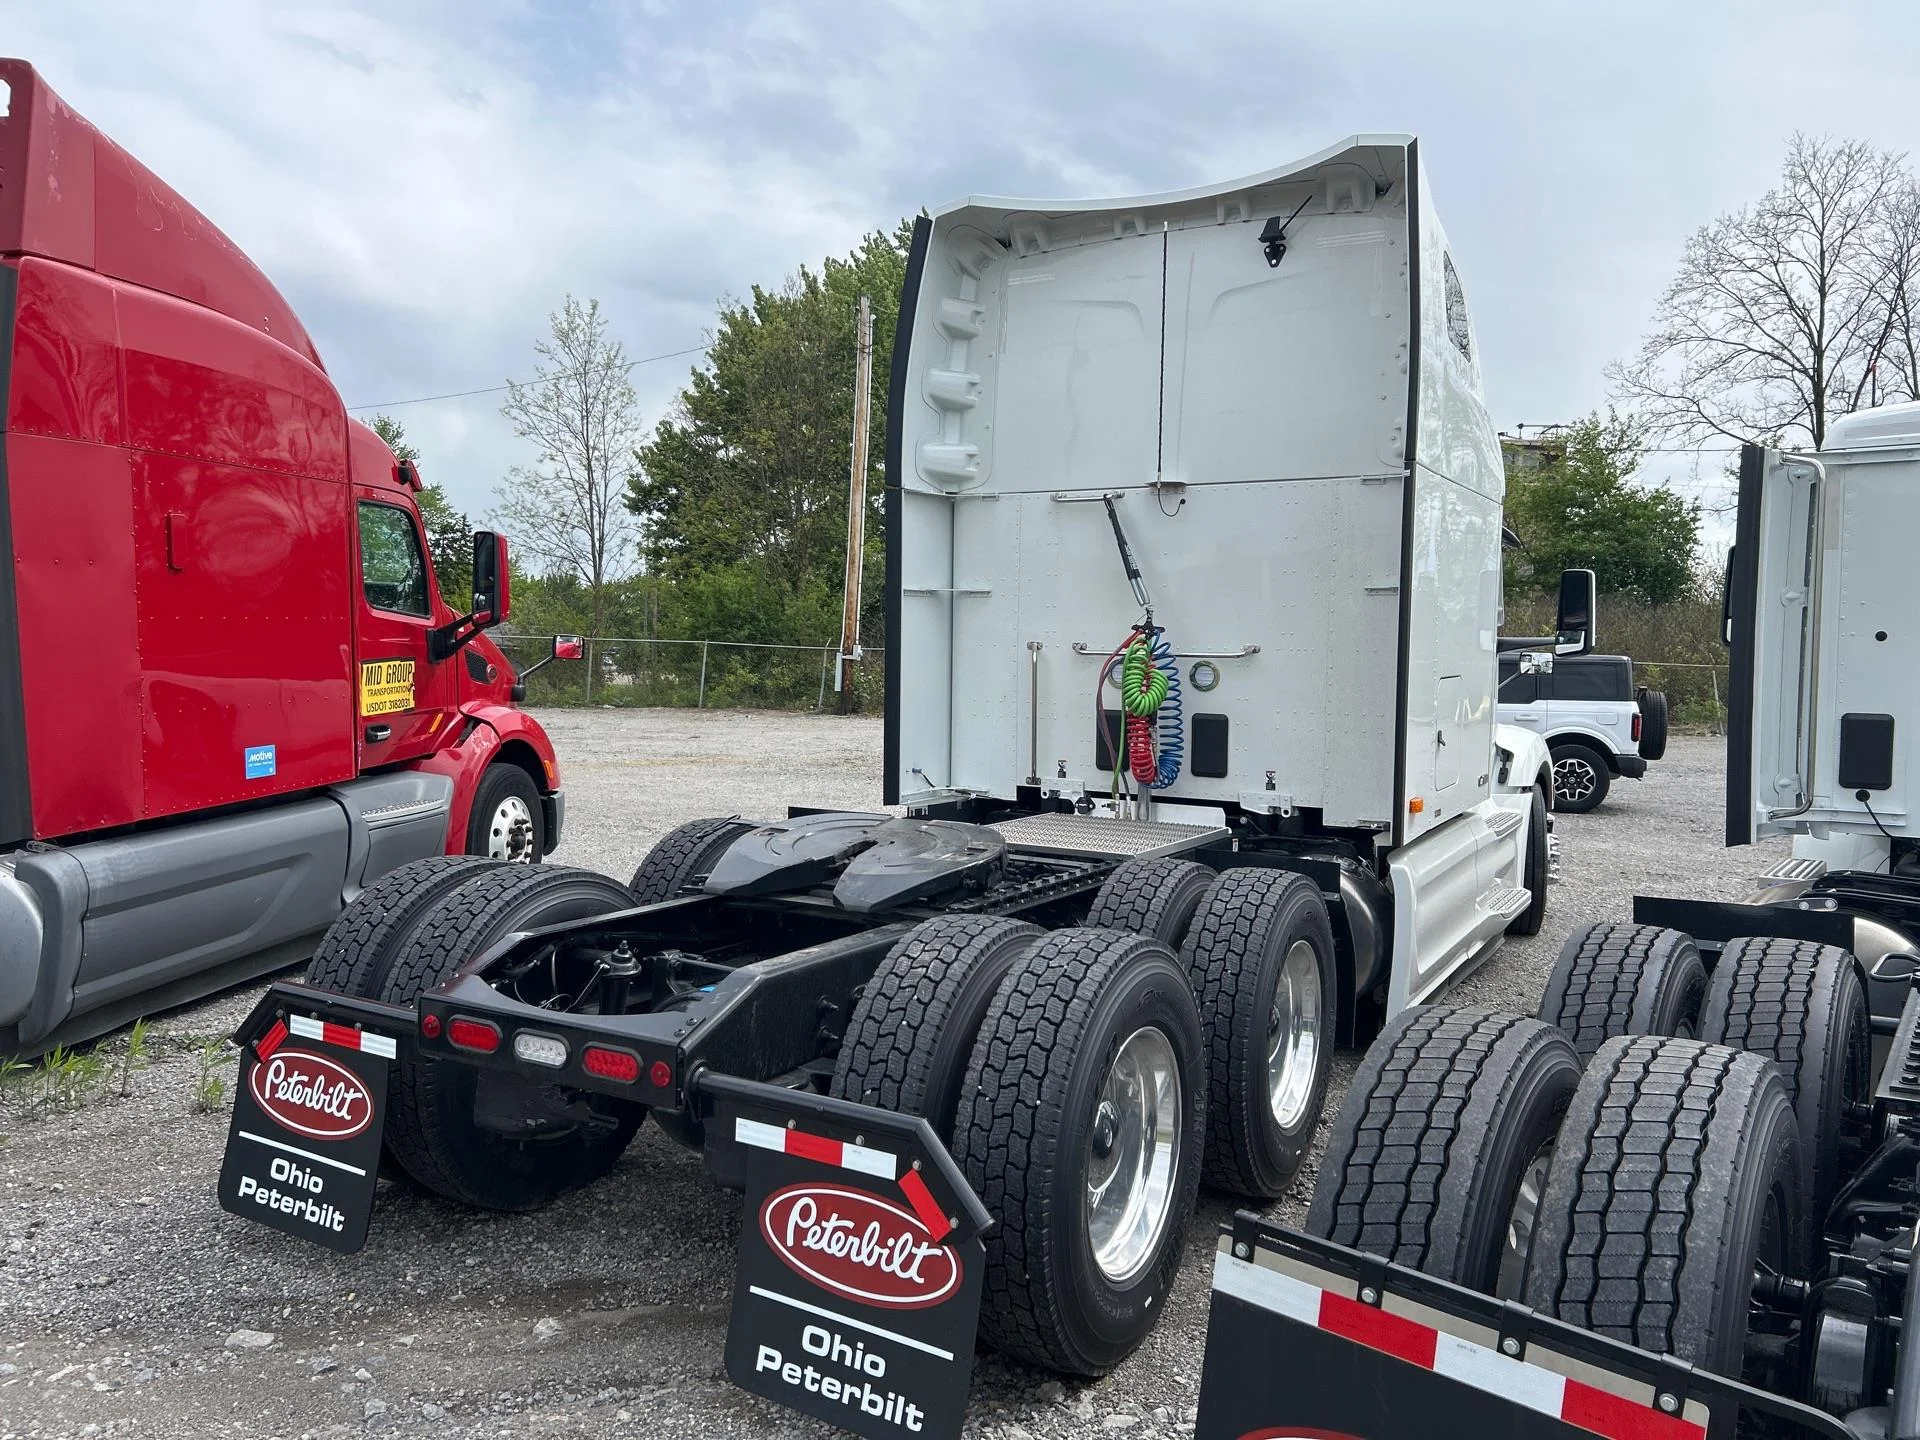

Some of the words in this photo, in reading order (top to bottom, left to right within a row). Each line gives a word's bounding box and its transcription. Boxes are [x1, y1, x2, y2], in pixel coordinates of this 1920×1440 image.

[365, 665, 382, 686] MID
[386, 663, 413, 684] GROUP
[367, 685, 411, 697] TRANSPORTATION
[366, 701, 387, 713] USDOT
[265, 1059, 362, 1120] Peterbilt
[270, 1158, 324, 1194] Ohio
[238, 1176, 345, 1232] Peterbilt
[786, 1196, 943, 1284] Peterbilt
[801, 1324, 886, 1378] Ohio
[756, 1344, 925, 1432] Peterbilt
